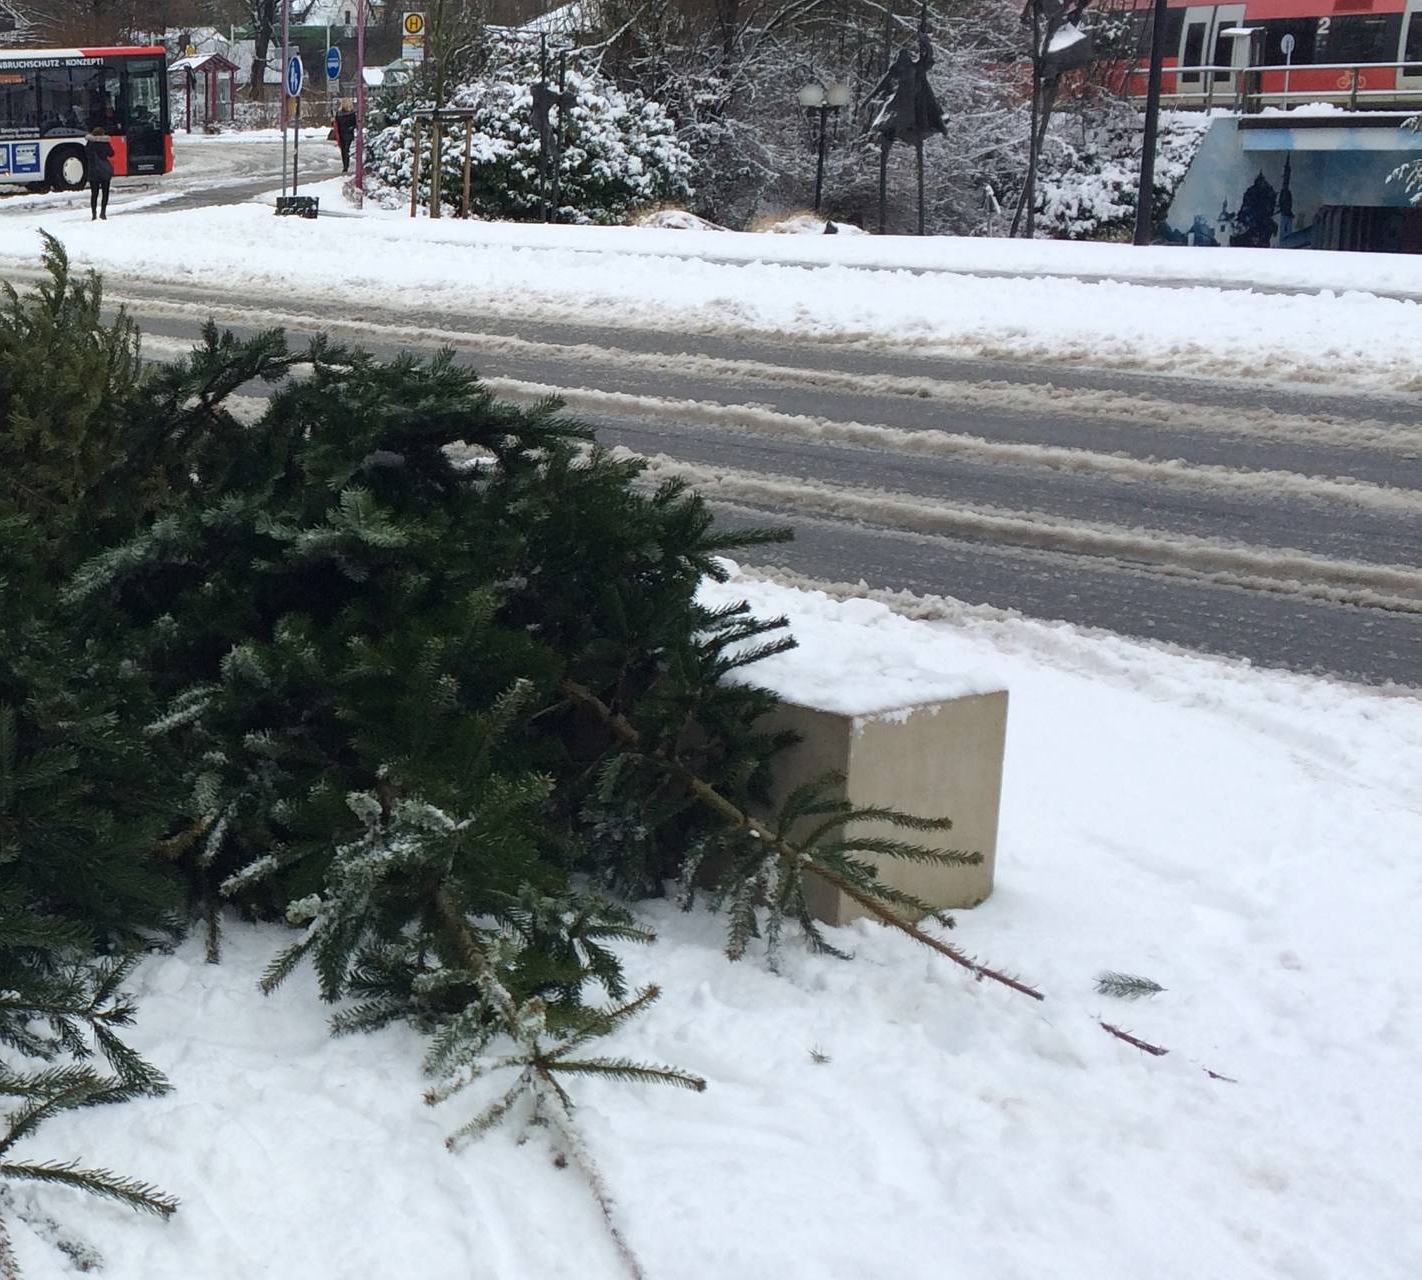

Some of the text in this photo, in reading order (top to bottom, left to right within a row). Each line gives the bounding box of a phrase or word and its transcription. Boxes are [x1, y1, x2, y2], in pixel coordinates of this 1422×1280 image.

[409, 18, 418, 29] H
[1316, 16, 1331, 34] 2
[66, 58, 104, 66] KONZEPT!
